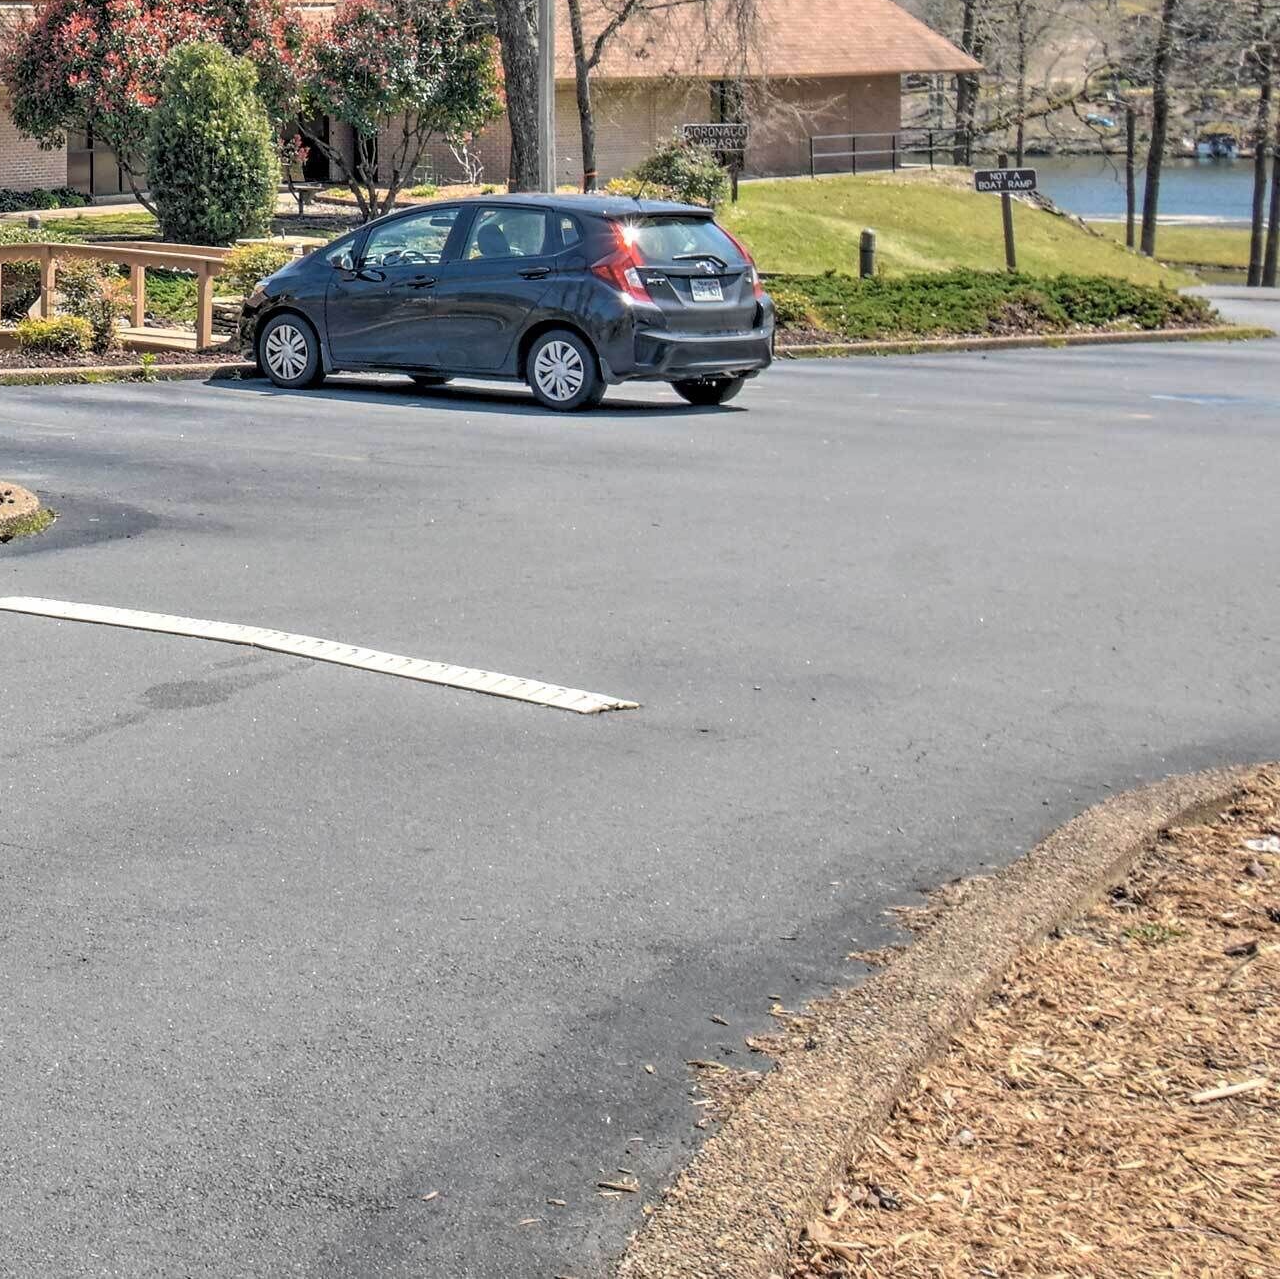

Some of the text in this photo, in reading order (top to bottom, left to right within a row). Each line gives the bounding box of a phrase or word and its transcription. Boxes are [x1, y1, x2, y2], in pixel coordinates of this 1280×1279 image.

[699, 138, 740, 149] IBRARY
[990, 172, 1020, 181] NOT A
[978, 179, 1032, 190] BOAT RAMP
